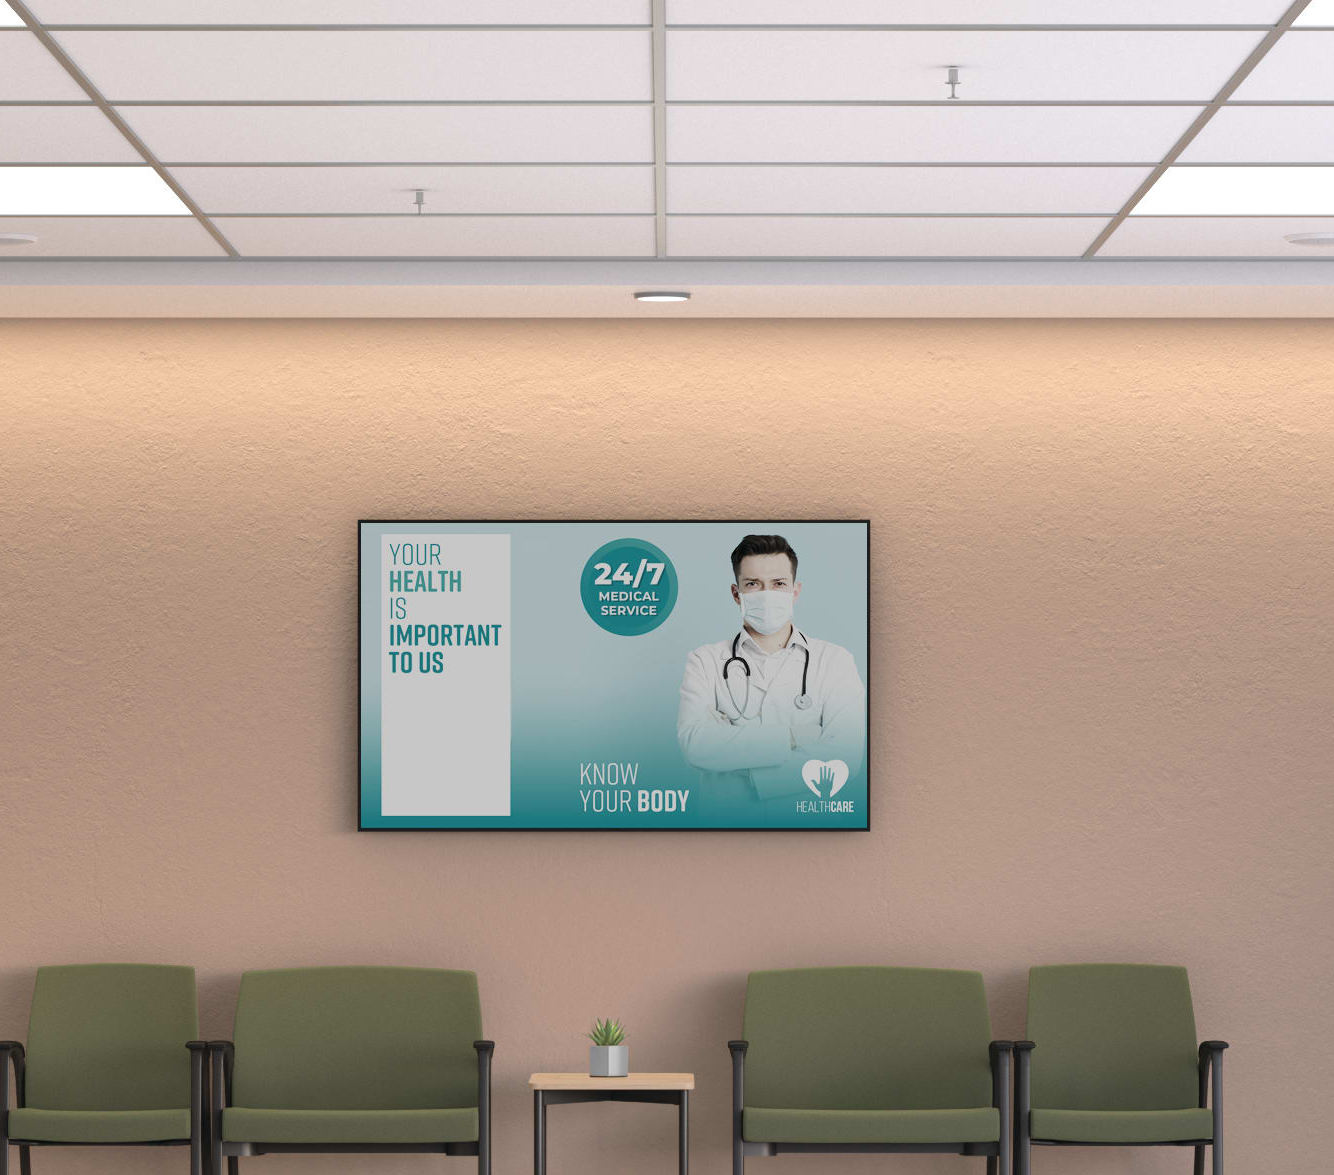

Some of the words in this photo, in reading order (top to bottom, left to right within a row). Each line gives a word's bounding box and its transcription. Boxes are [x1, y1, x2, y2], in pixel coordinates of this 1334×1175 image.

[389, 543, 442, 566] YOUR
[389, 570, 462, 593] HEALTH
[593, 558, 666, 589] 24/7
[389, 597, 407, 620] IS
[598, 591, 660, 603] MEDICAL
[600, 605, 657, 617] SERVICE
[389, 624, 502, 647] IMPORTANT
[389, 651, 413, 674] TO
[419, 651, 444, 674] US
[580, 762, 639, 786] KNOW
[580, 790, 631, 813] YOUR
[637, 790, 689, 813] BODY
[796, 800, 854, 814] HEALTHCARE
